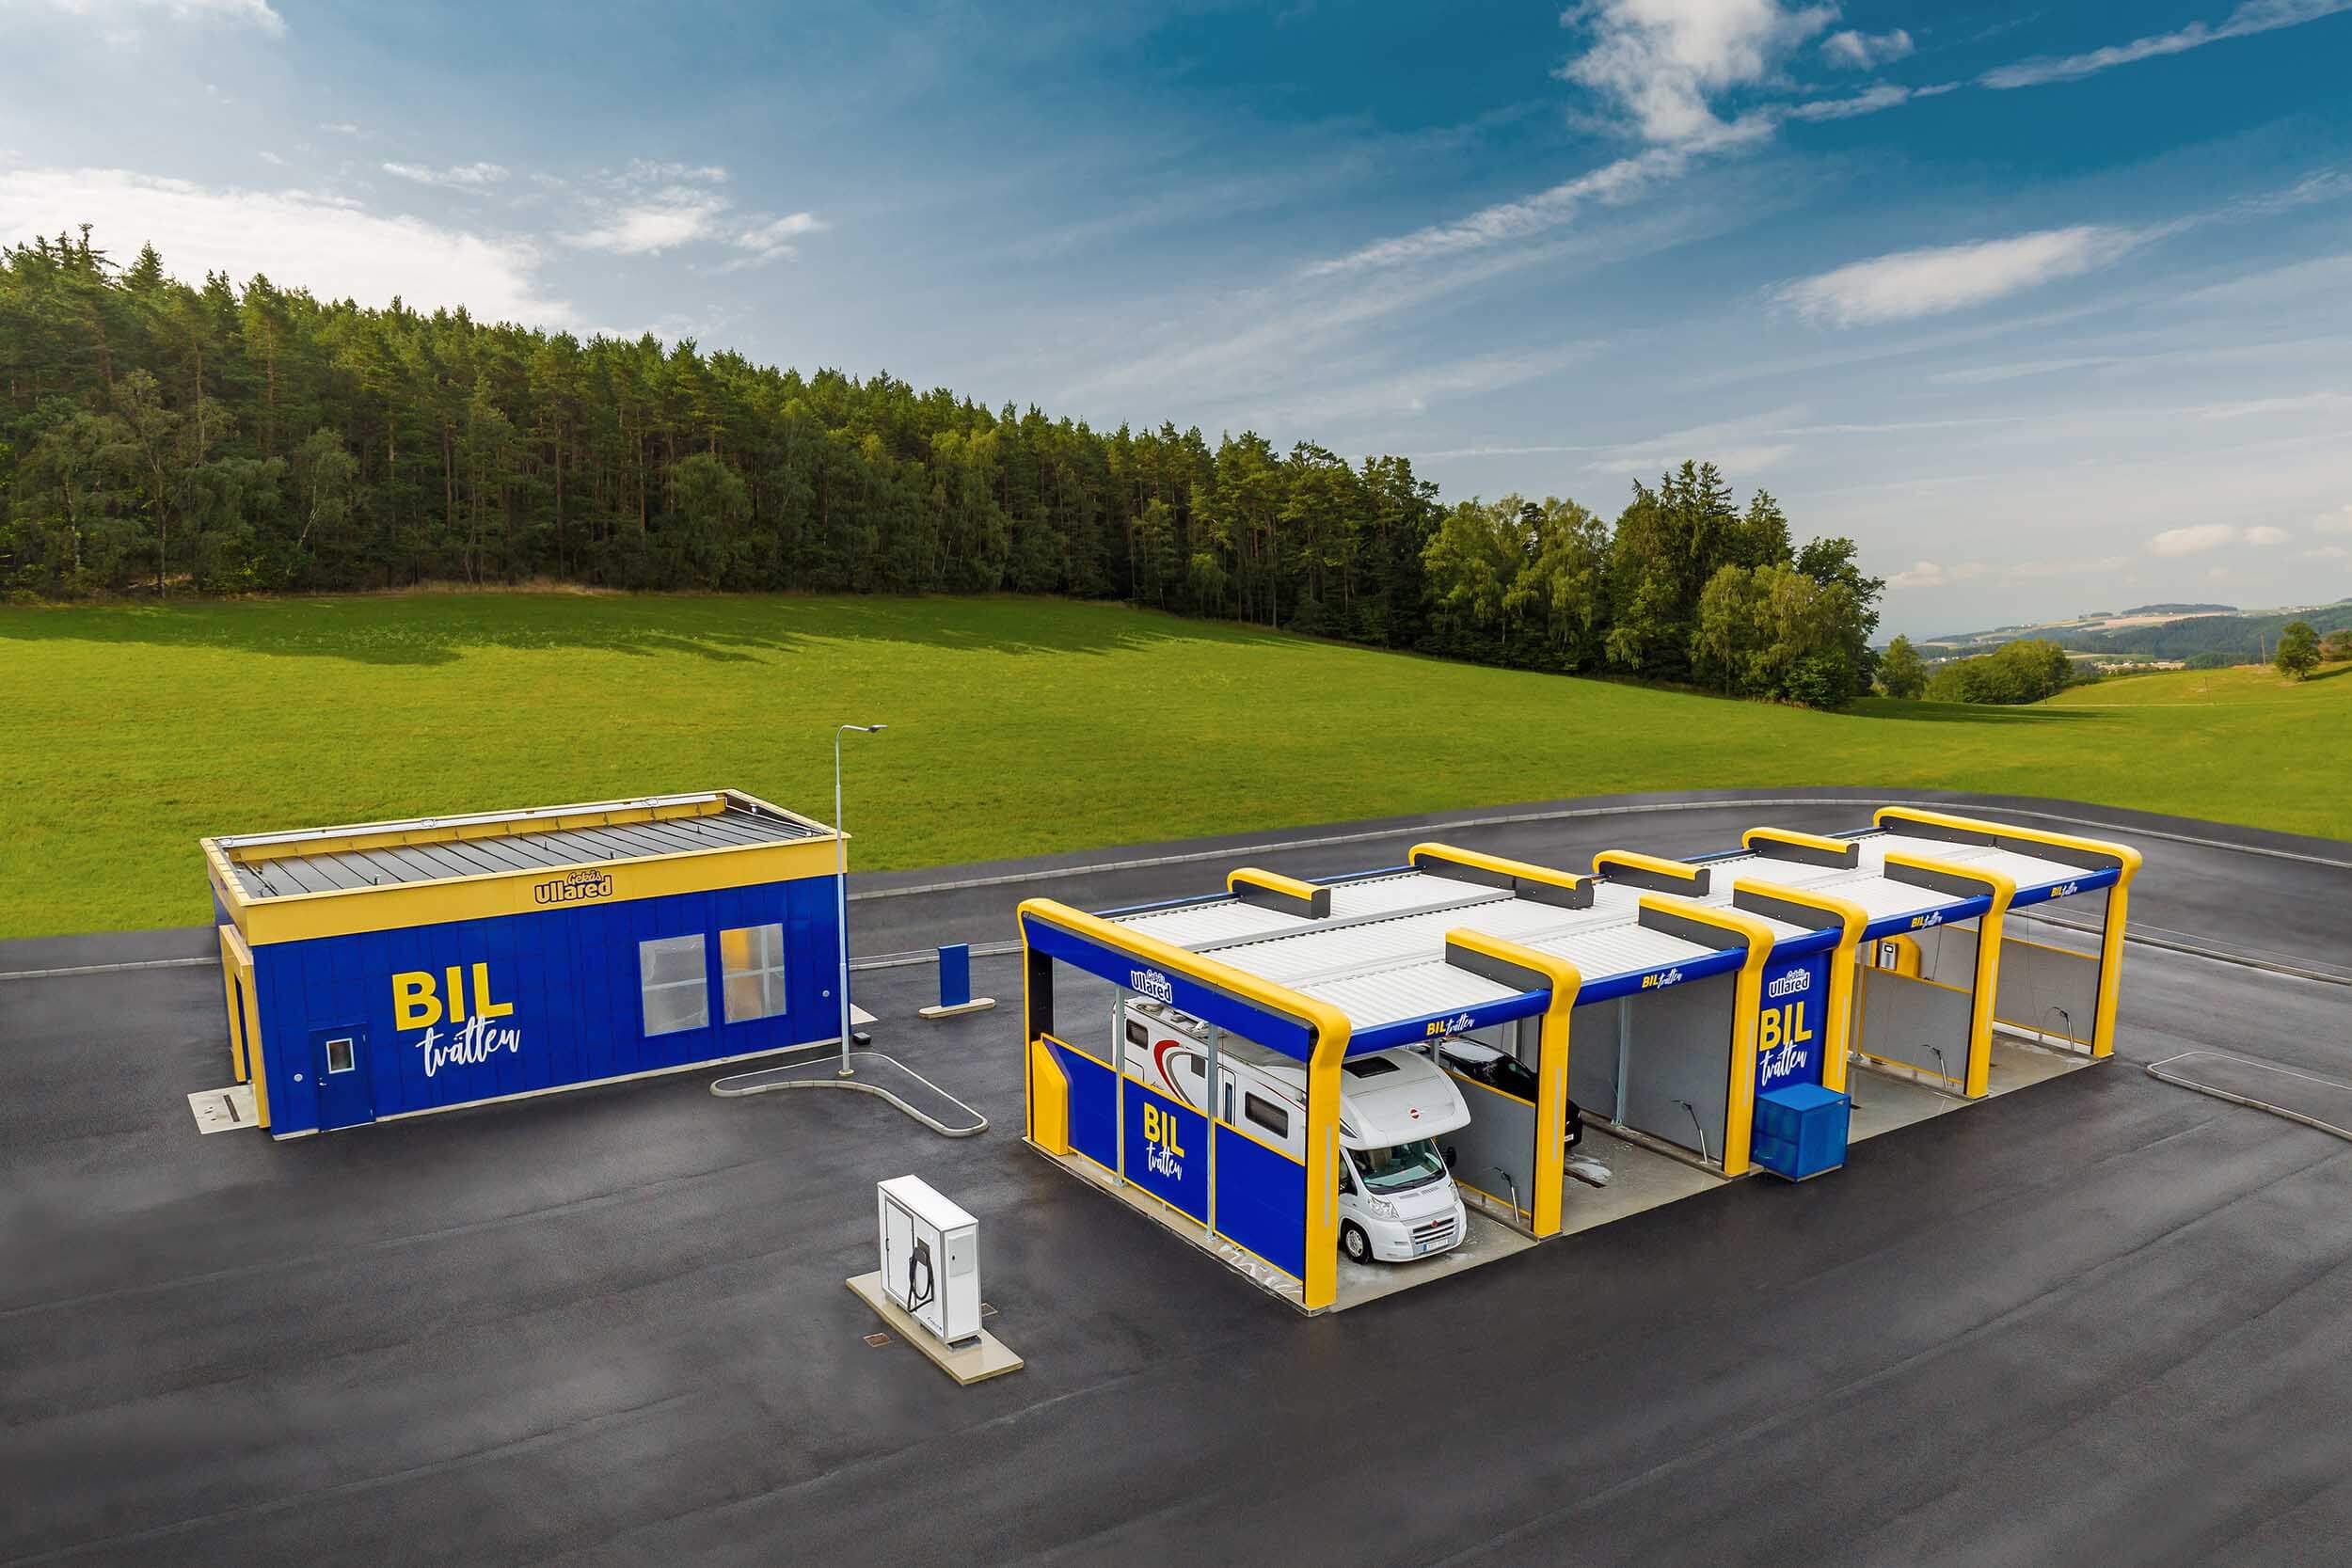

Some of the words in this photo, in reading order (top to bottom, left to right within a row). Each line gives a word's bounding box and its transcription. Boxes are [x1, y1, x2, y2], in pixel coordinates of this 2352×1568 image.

[534, 875, 613, 904] Ullared
[567, 870, 602, 885] Gekås
[391, 962, 514, 1032] BIL
[1130, 970, 1173, 1005] Ullared
[1642, 974, 1658, 989] BIL
[1769, 972, 1811, 998] Ullared
[1426, 1020, 1446, 1036] BIL
[1759, 1001, 1812, 1052] BIL
[415, 1013, 521, 1078] tvätten
[1144, 1101, 1185, 1158] BIL
